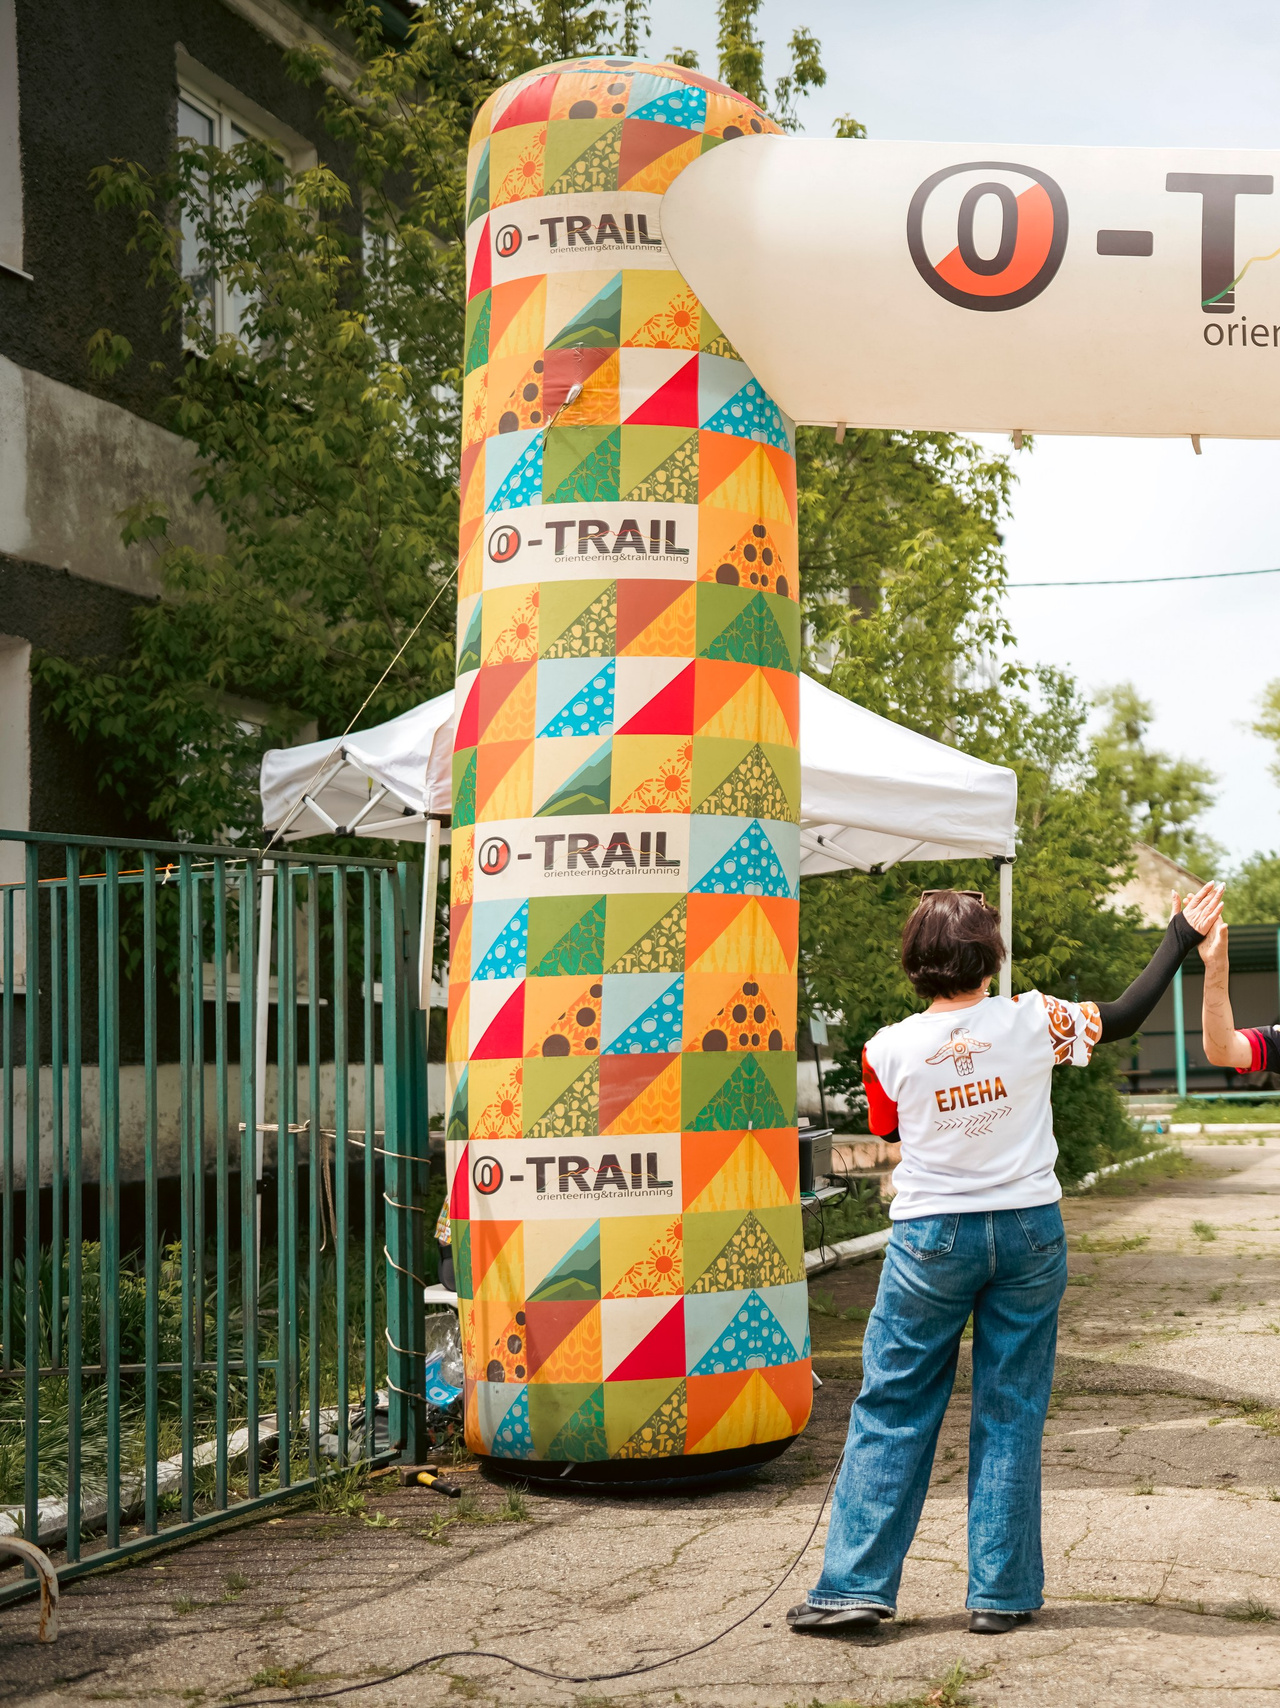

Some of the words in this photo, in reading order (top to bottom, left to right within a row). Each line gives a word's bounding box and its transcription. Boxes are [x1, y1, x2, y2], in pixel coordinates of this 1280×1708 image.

[550, 243, 662, 255] orienteering&trailrunning
[555, 553, 690, 564] orienteering&trailrunning
[544, 866, 680, 878] orienteering&trailrunning
[935, 1076, 1008, 1113] ЕЛЕНА
[537, 1188, 673, 1201] orienteering&trailrunning
